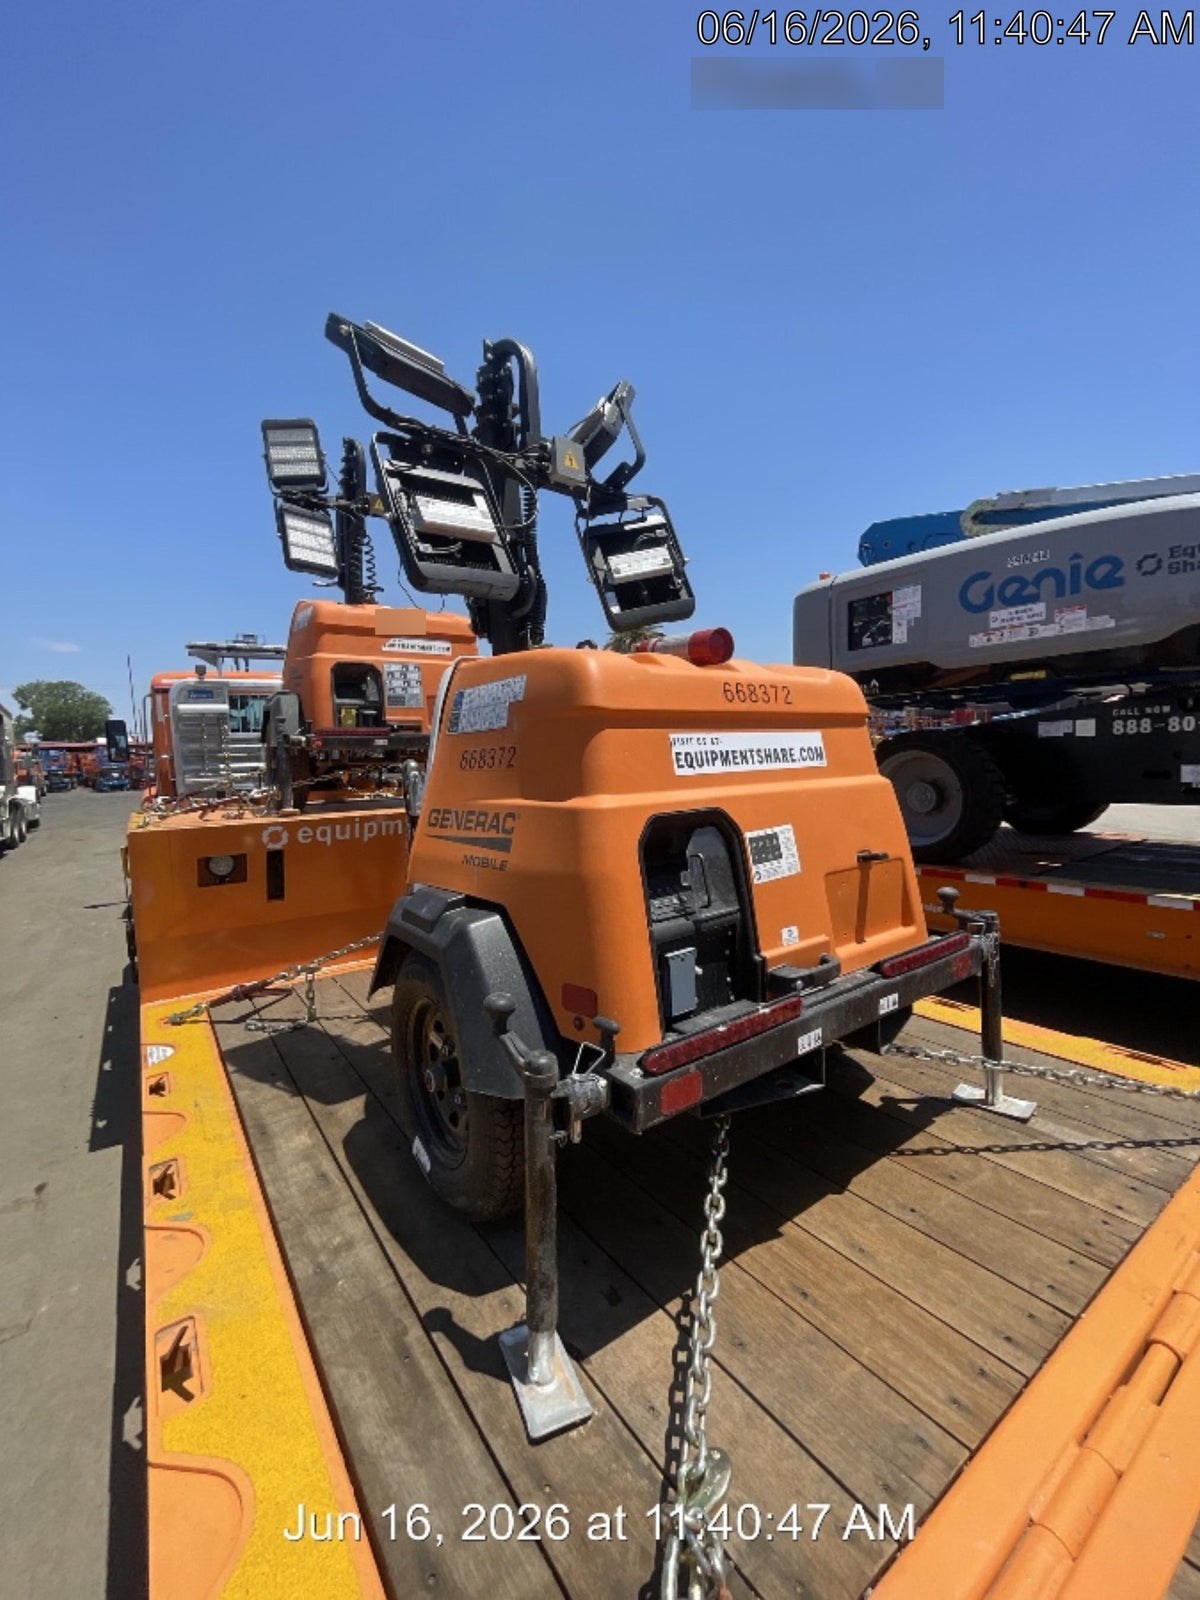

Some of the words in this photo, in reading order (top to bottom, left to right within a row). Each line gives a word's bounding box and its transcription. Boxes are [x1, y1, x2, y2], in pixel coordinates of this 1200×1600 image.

[1168, 544, 1200, 559] Eq
[1168, 560, 1200, 575] Sh
[959, 553, 1125, 614] Genie
[722, 681, 793, 705] 668372
[1112, 707, 1140, 717] CALL
[1145, 704, 1171, 714] NOW
[460, 746, 516, 770] 668372
[674, 746, 824, 770] EQUIPMENTSHARE.COM
[297, 817, 403, 847] equipm
[427, 808, 516, 835] GENERAC
[462, 854, 508, 872] MOBILE
